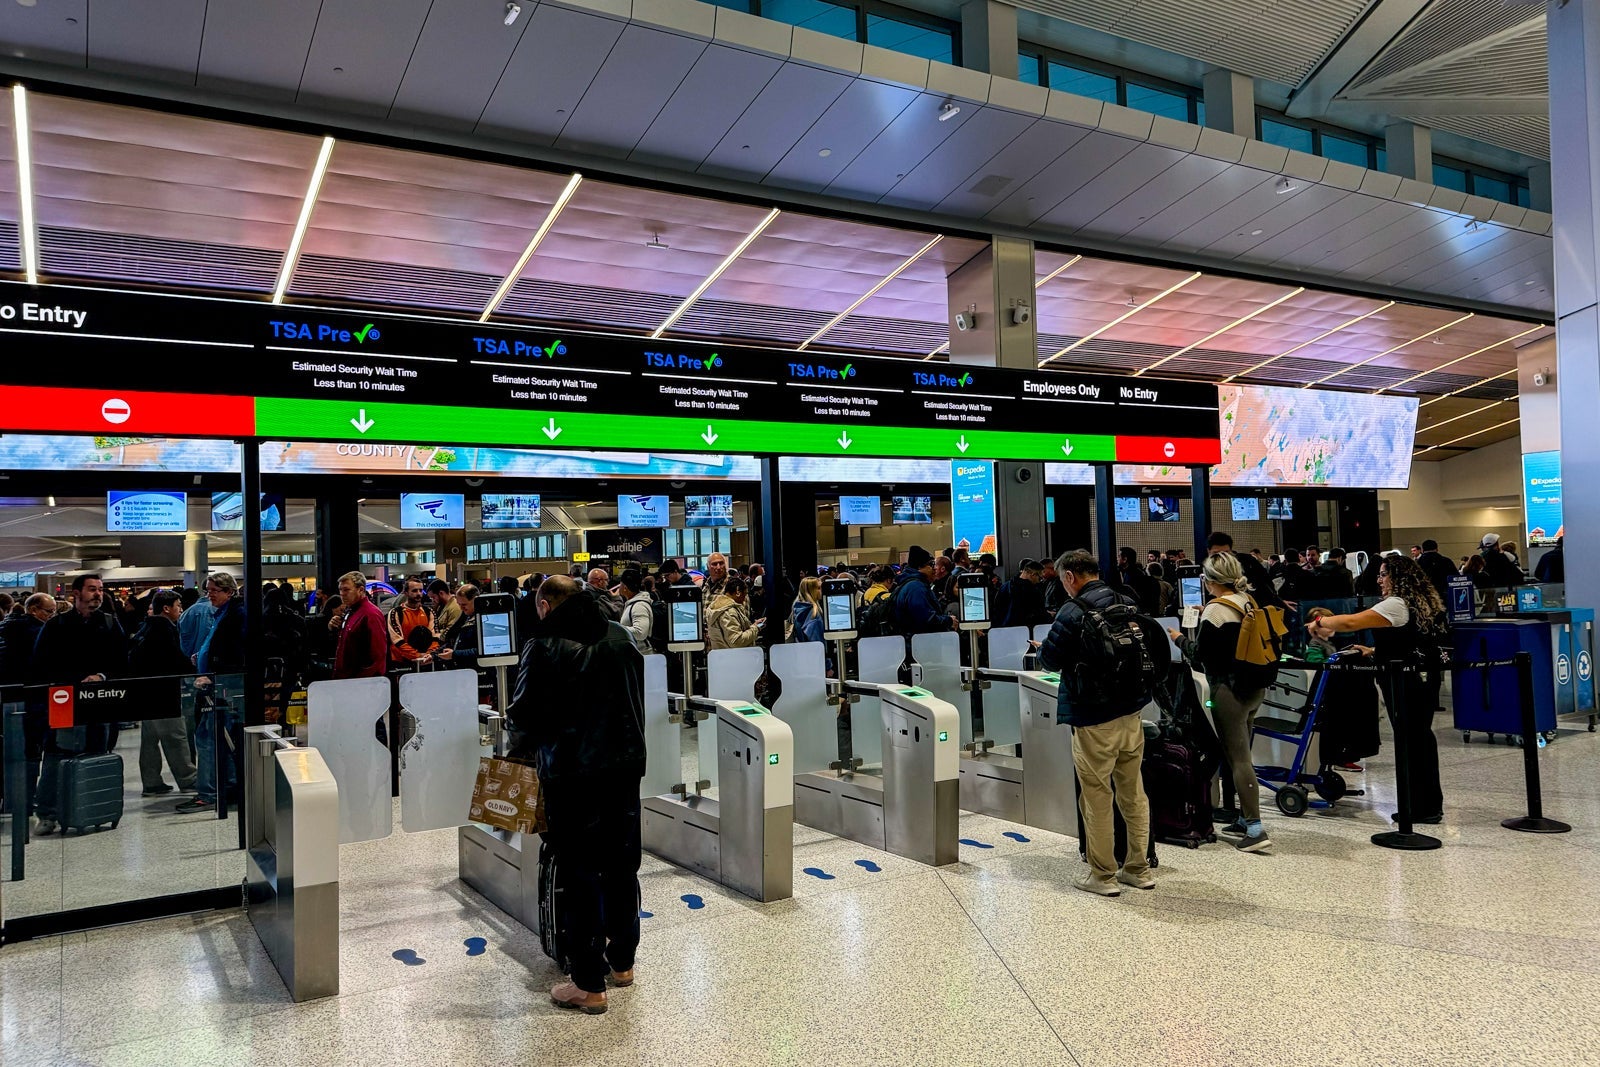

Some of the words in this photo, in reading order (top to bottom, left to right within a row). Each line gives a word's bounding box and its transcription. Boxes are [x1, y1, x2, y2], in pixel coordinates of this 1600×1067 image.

[0, 306, 15, 319] o
[23, 303, 86, 328] Entry
[270, 321, 312, 340] TSA
[473, 338, 510, 354] TSA
[644, 352, 675, 367] TSA
[293, 361, 336, 372] Estimated
[338, 364, 373, 376] Security
[375, 367, 394, 376] Wait
[396, 368, 417, 377] Time
[788, 363, 815, 377] TSA
[314, 378, 335, 387] Less
[337, 380, 356, 388] than
[359, 381, 369, 389] 10
[372, 382, 405, 391] minutes
[493, 375, 529, 384] Estimated
[531, 377, 561, 388] Security
[562, 379, 578, 388] Wait
[580, 380, 597, 389] Time
[913, 372, 936, 385] TSA
[660, 386, 691, 394] Estimated
[692, 388, 717, 397] Security
[733, 390, 748, 398] Time
[1024, 380, 1076, 396] Employees
[1078, 384, 1100, 398] Only
[1120, 387, 1133, 398] No
[1135, 388, 1158, 402] Entry
[511, 390, 529, 398] Less
[559, 393, 587, 402] minutes
[801, 394, 828, 403] Estimated
[829, 396, 851, 405] Security
[716, 402, 739, 410] minutes
[949, 403, 968, 412] Security
[336, 443, 408, 458] COUNTY
[964, 465, 986, 475] Expedia
[607, 542, 642, 552] audible
[80, 691, 95, 699] No
[98, 689, 126, 699] Entry
[488, 801, 499, 810] OLD
[499, 805, 514, 813] NAVY
